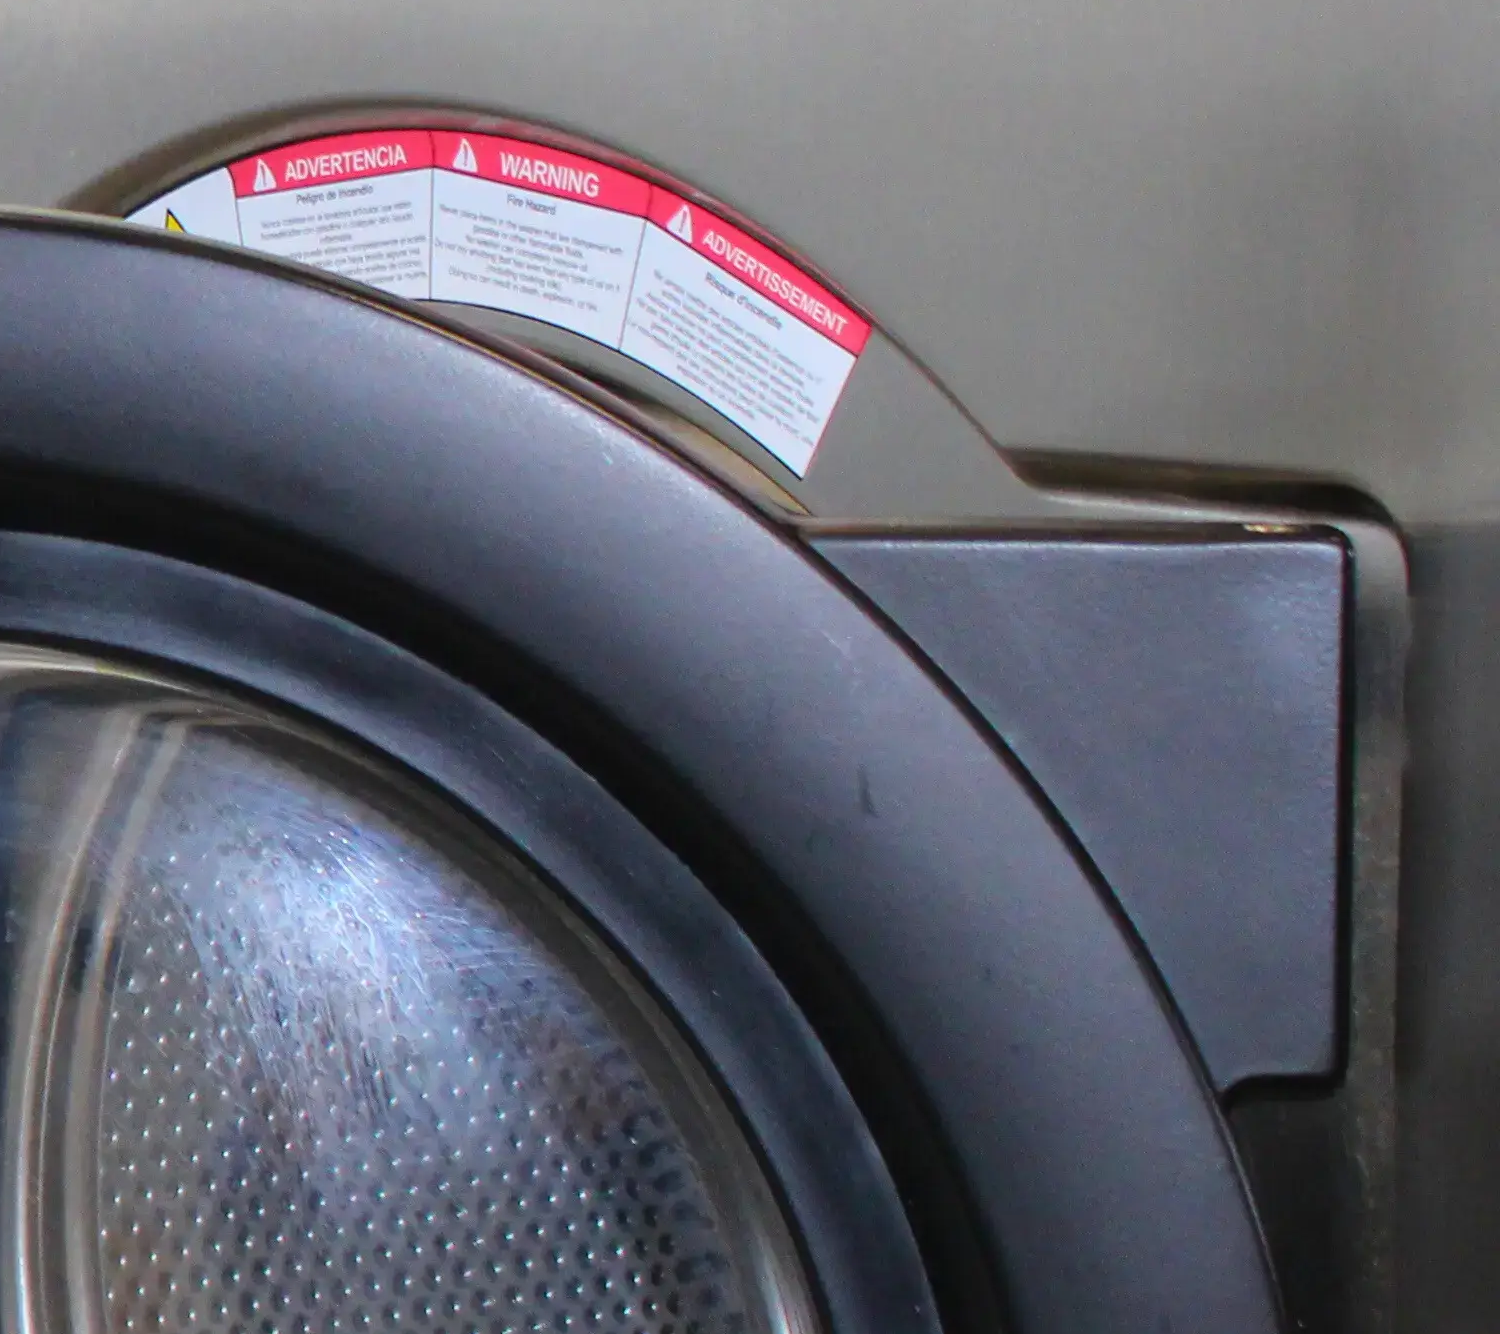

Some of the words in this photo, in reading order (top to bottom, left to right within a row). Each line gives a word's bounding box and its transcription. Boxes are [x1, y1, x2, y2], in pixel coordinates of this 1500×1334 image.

[285, 143, 408, 183] ADVERTENCIA
[499, 150, 600, 198] WARNING
[326, 189, 338, 201] de
[506, 192, 525, 208] Fire
[525, 197, 557, 216] Hazard
[702, 229, 849, 336] ADVERTISSEMENT
